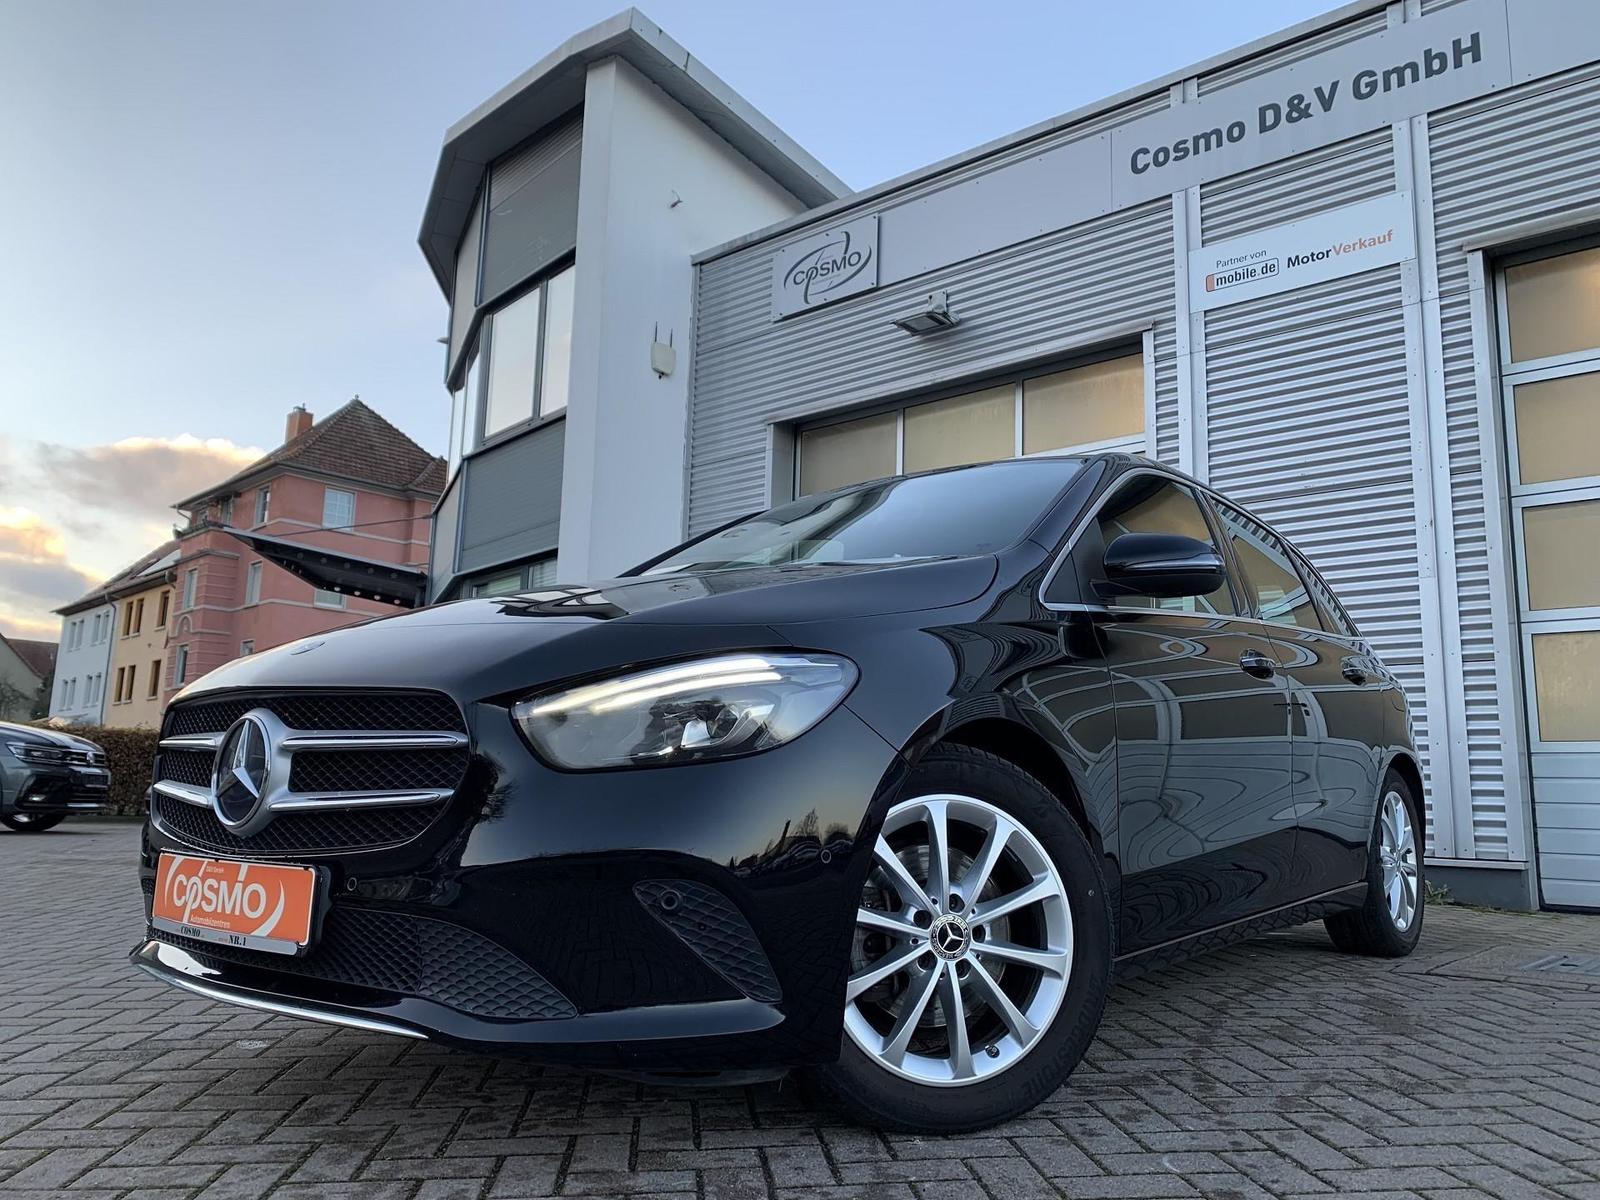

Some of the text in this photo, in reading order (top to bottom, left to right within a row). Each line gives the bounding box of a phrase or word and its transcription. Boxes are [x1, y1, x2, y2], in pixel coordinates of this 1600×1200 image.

[1130, 31, 1482, 175] Cosmo D&V GmbH
[793, 251, 862, 286] COSMO
[1215, 260, 1277, 287] mobile.de
[1216, 249, 1267, 269] Partner von
[173, 873, 267, 919] COSMO
[180, 925, 201, 938] COSMO
